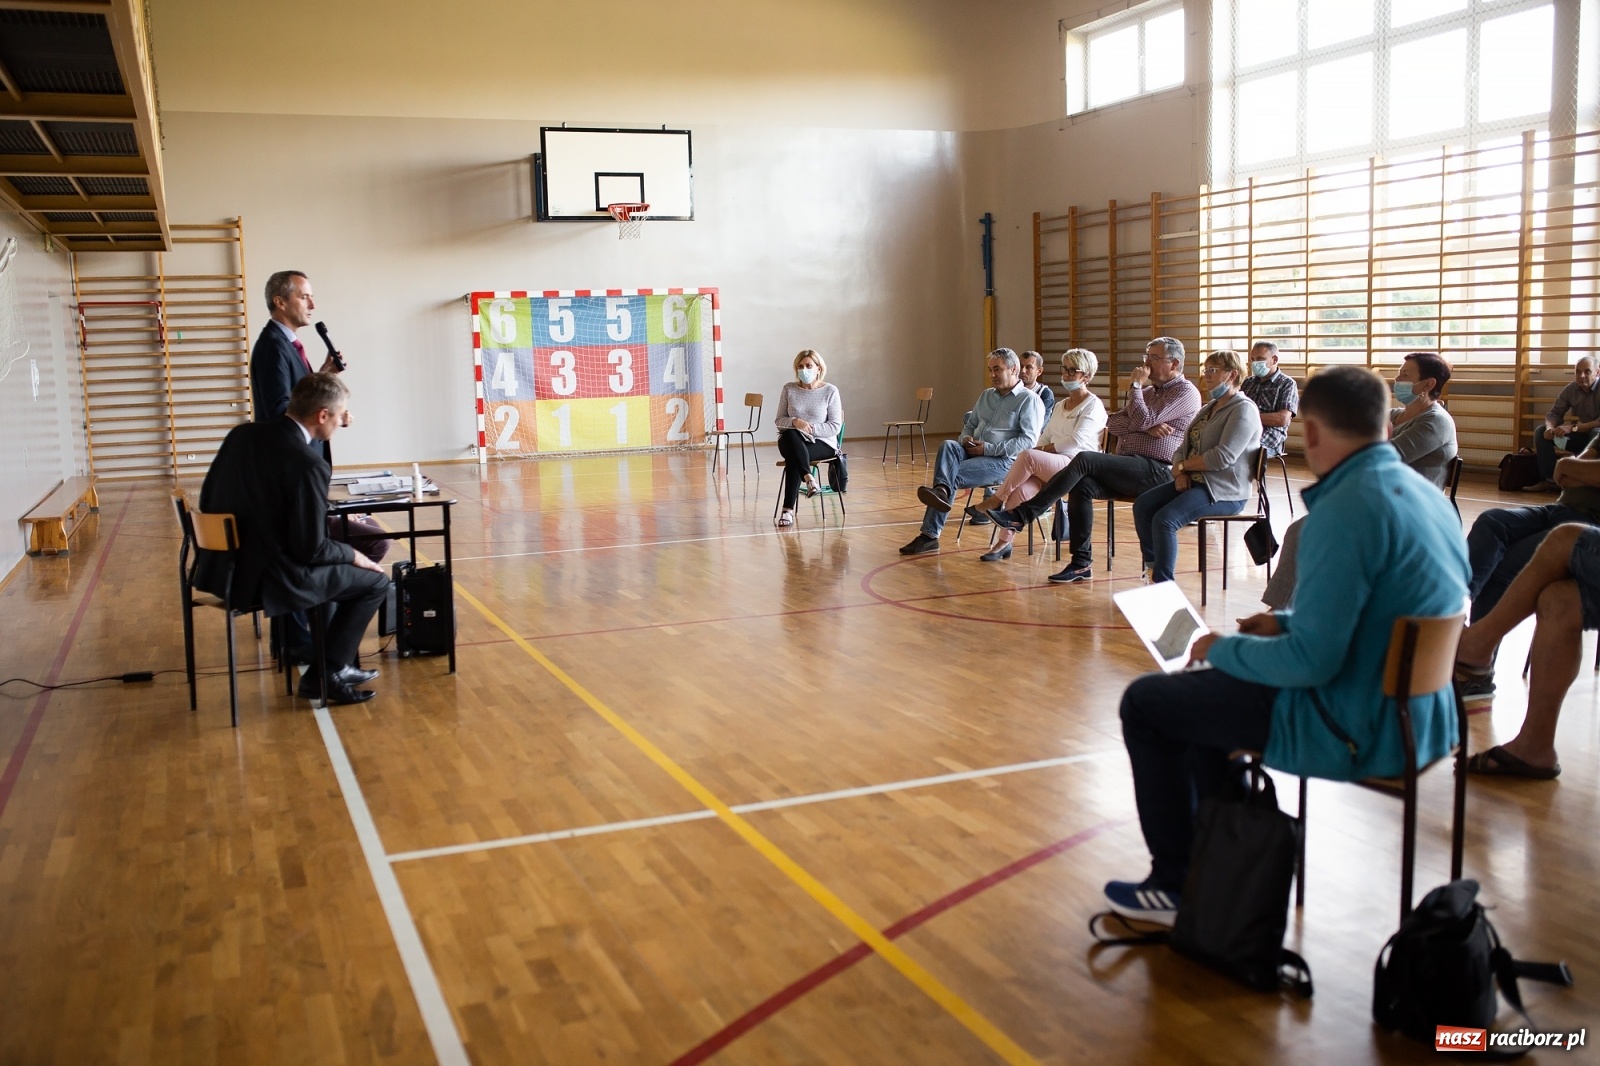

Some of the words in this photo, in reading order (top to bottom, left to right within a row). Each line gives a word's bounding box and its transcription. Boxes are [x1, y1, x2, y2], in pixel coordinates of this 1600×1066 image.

[489, 300, 517, 344] 6
[549, 299, 575, 343] 5
[606, 297, 632, 341] 5
[662, 295, 688, 339] 6
[492, 353, 518, 397] 4
[551, 351, 577, 396] 3
[607, 349, 634, 394] 3
[663, 347, 689, 389] 4
[494, 405, 520, 450] 2
[552, 404, 571, 447] 1
[609, 401, 628, 444] 1
[665, 398, 690, 441] 2
